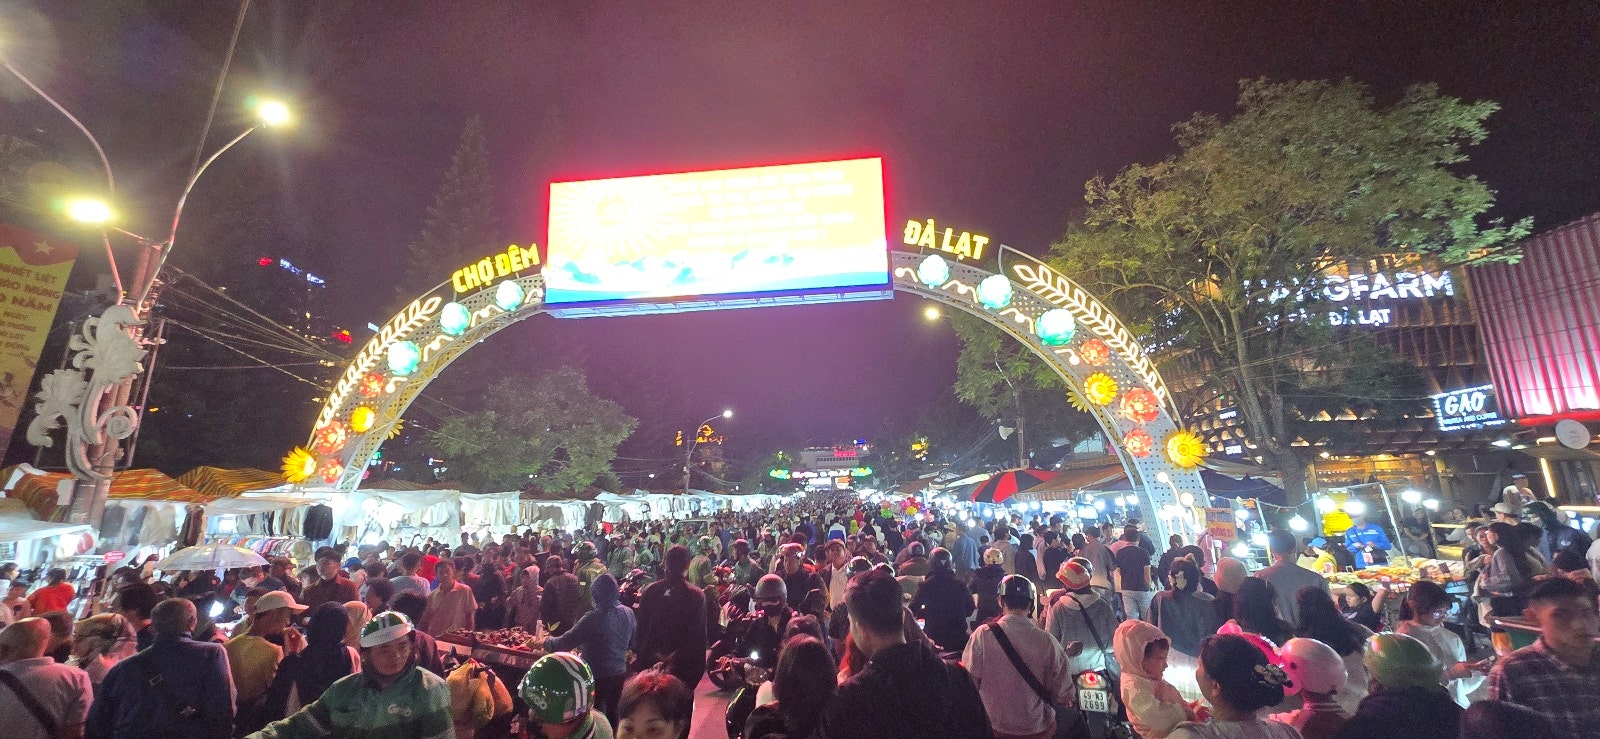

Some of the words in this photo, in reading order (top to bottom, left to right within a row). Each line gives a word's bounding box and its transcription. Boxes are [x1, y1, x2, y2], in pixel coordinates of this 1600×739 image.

[903, 218, 936, 249] ĐÀ
[941, 227, 989, 260] LẠT
[452, 256, 495, 293] CHỢ
[494, 242, 540, 277] ĐÊM
[1358, 308, 1391, 327] LẠT
